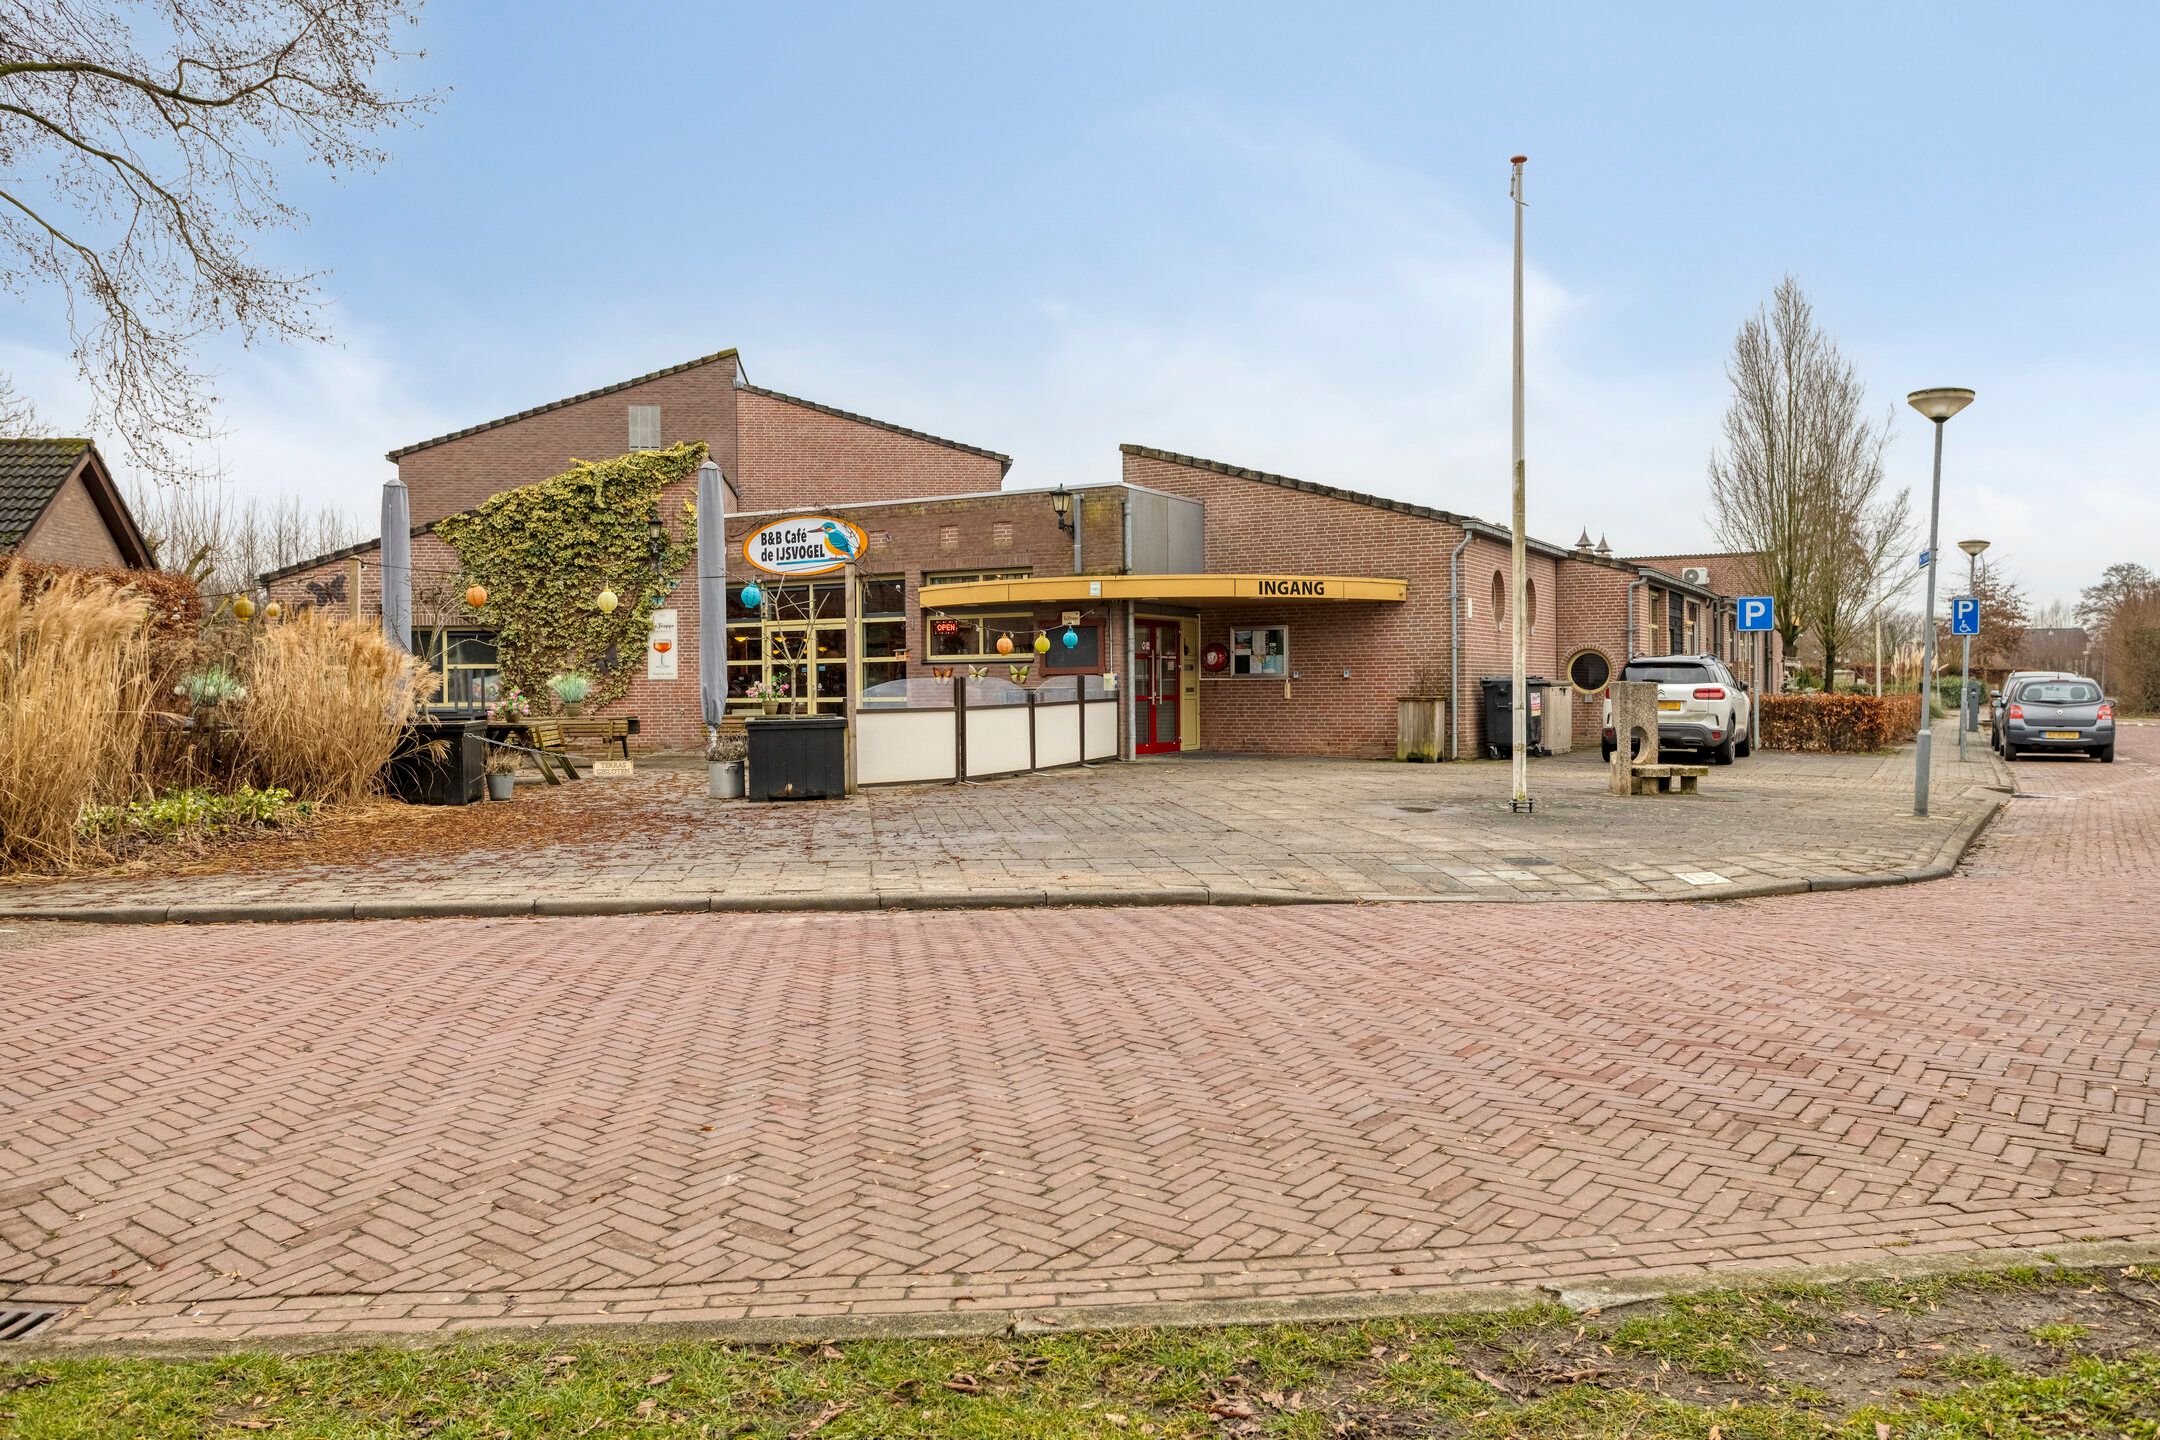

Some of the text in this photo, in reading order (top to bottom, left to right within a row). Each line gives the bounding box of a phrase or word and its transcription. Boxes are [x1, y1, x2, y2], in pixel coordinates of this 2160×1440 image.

[761, 529, 807, 546] B&B Café
[761, 544, 825, 562] de IJSVOGEL
[1258, 580, 1325, 596] INGANG
[1745, 601, 1766, 627] P
[1958, 600, 1974, 619] P
